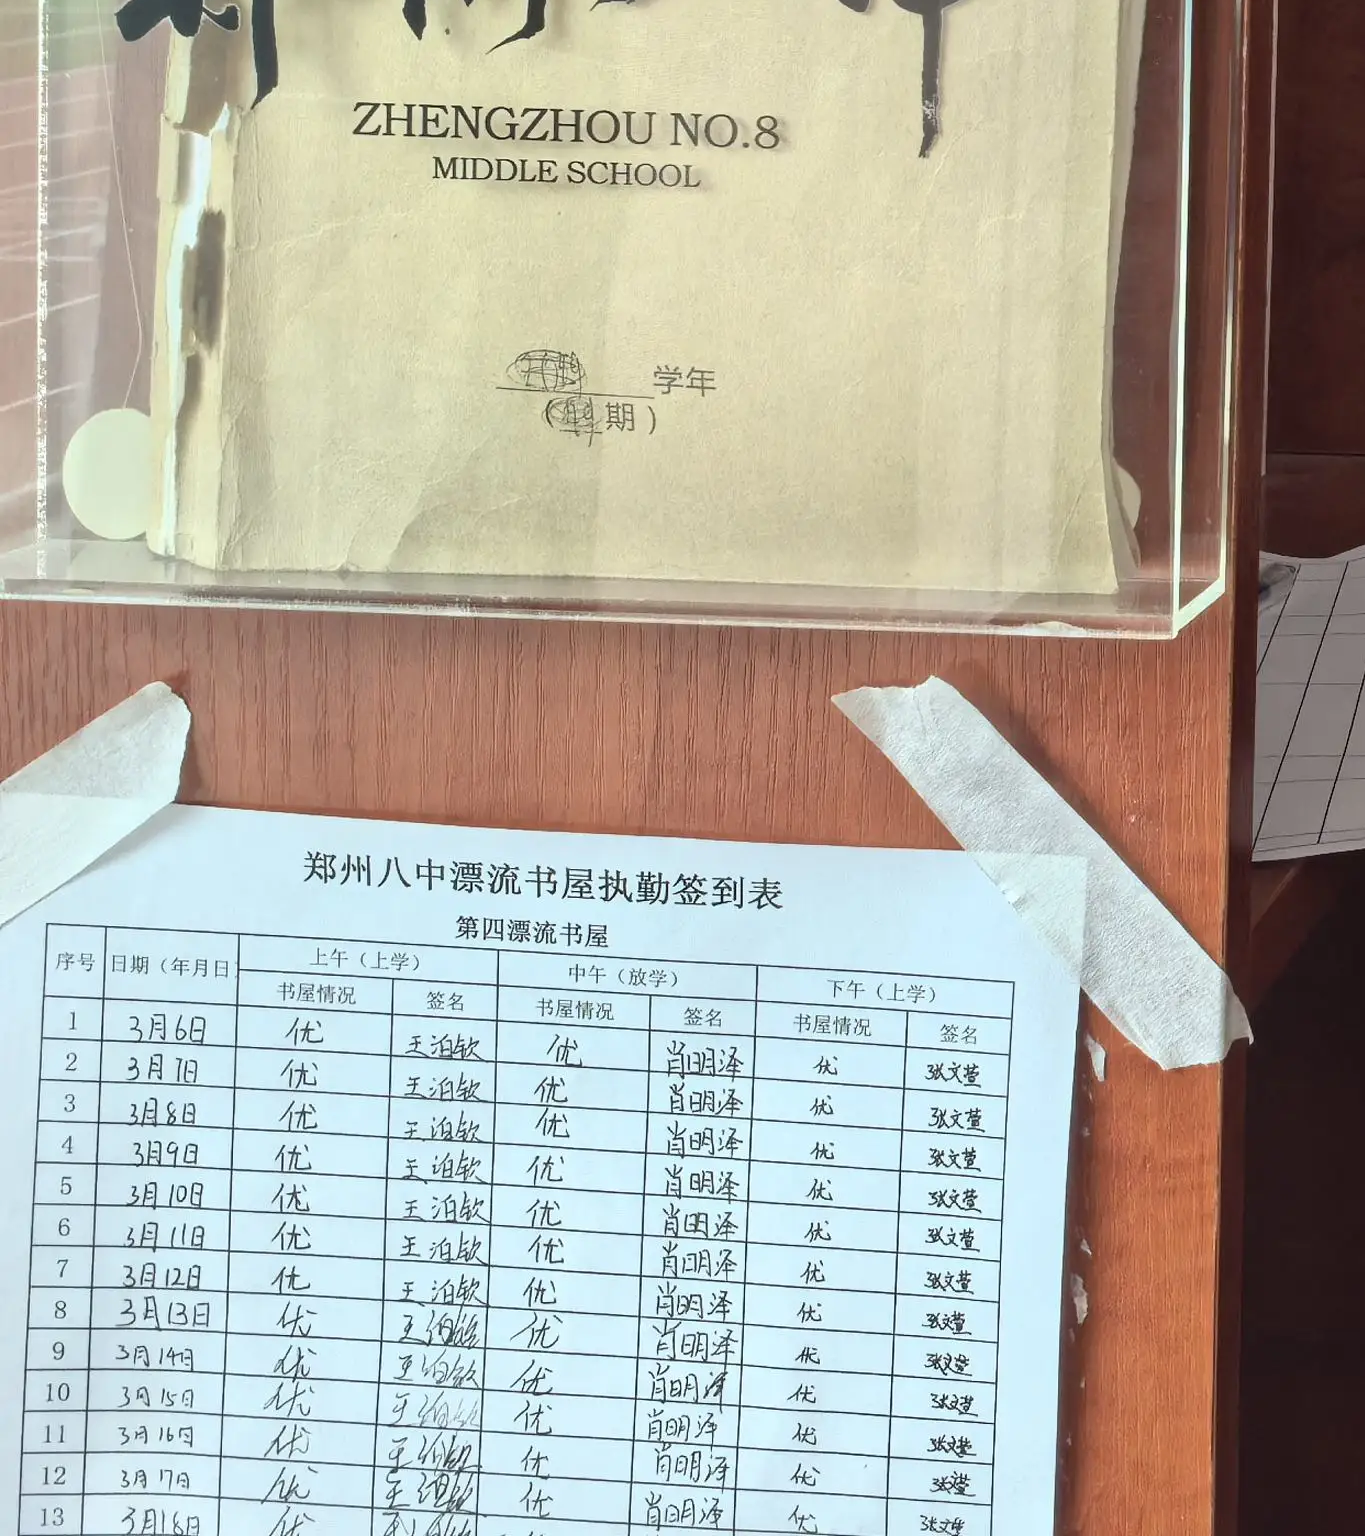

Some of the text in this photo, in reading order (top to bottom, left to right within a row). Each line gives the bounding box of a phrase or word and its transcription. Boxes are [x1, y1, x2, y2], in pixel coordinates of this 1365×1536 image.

[352, 101, 782, 150] ZHENGZHOU NO.8
[432, 156, 702, 188] MIDDLE SCHOOL
[653, 364, 717, 397] 学年
[303, 850, 785, 910] 郑州八中漂流书屋执勤签到表
[455, 915, 610, 949] 第四漂流书屋
[55, 951, 238, 980] 序号 日期（年月日
[308, 947, 938, 1004] 上午（上学） 中午（放学） 下午（上学）
[69, 1012, 76, 1030] 1
[277, 981, 979, 1046] 书屋情况 签名 书屋情况 签名 书屋情况 签名
[65, 1052, 77, 1071] 2
[129, 1014, 206, 1042] 3月6日
[285, 1017, 323, 1046] 优
[547, 1034, 582, 1064] 优
[813, 1056, 838, 1076] 优
[126, 1054, 198, 1083] 3月7日
[280, 1059, 318, 1089] 优
[534, 1076, 568, 1103] 优
[810, 1095, 834, 1116] 优
[64, 1094, 75, 1112] 3
[62, 1136, 72, 1154] 4
[131, 1097, 196, 1124] 3月8日
[279, 1100, 318, 1130] 优
[535, 1108, 570, 1138] 优
[810, 1141, 834, 1160] 优
[60, 1176, 72, 1195] 5
[133, 1140, 198, 1165] 3月9日
[275, 1144, 312, 1170] 优
[526, 1155, 564, 1184] 优
[805, 1179, 833, 1201] 优
[58, 1218, 70, 1236] 6
[131, 1182, 204, 1206] 3月10日
[271, 1183, 310, 1212] 优
[526, 1199, 562, 1226] 优
[804, 1220, 832, 1243] 优
[57, 1259, 68, 1278] 7
[127, 1222, 205, 1247] 3月11日
[271, 1221, 311, 1251] 优
[528, 1234, 564, 1264] 优
[800, 1260, 825, 1284] 优
[123, 1262, 201, 1287] 3月12日
[523, 1277, 557, 1307] 优
[797, 1302, 822, 1323] 优
[55, 1301, 66, 1319] 8
[117, 1295, 210, 1327] 3月13日
[510, 1312, 563, 1349] 优
[52, 1341, 64, 1360] 9
[116, 1345, 194, 1370] 3月14日
[787, 1384, 816, 1403] 优
[46, 1382, 70, 1402] 10
[118, 1386, 194, 1408] 3月15日
[514, 1400, 552, 1433] 优
[792, 1423, 817, 1445] 优
[44, 1425, 64, 1443] 11
[118, 1426, 193, 1448] 3月16日
[521, 1445, 548, 1474] 优
[790, 1463, 820, 1486] 优
[43, 1467, 65, 1485] 12
[120, 1469, 191, 1492] 3月17日
[520, 1481, 553, 1516] 优
[41, 1507, 64, 1526] 13
